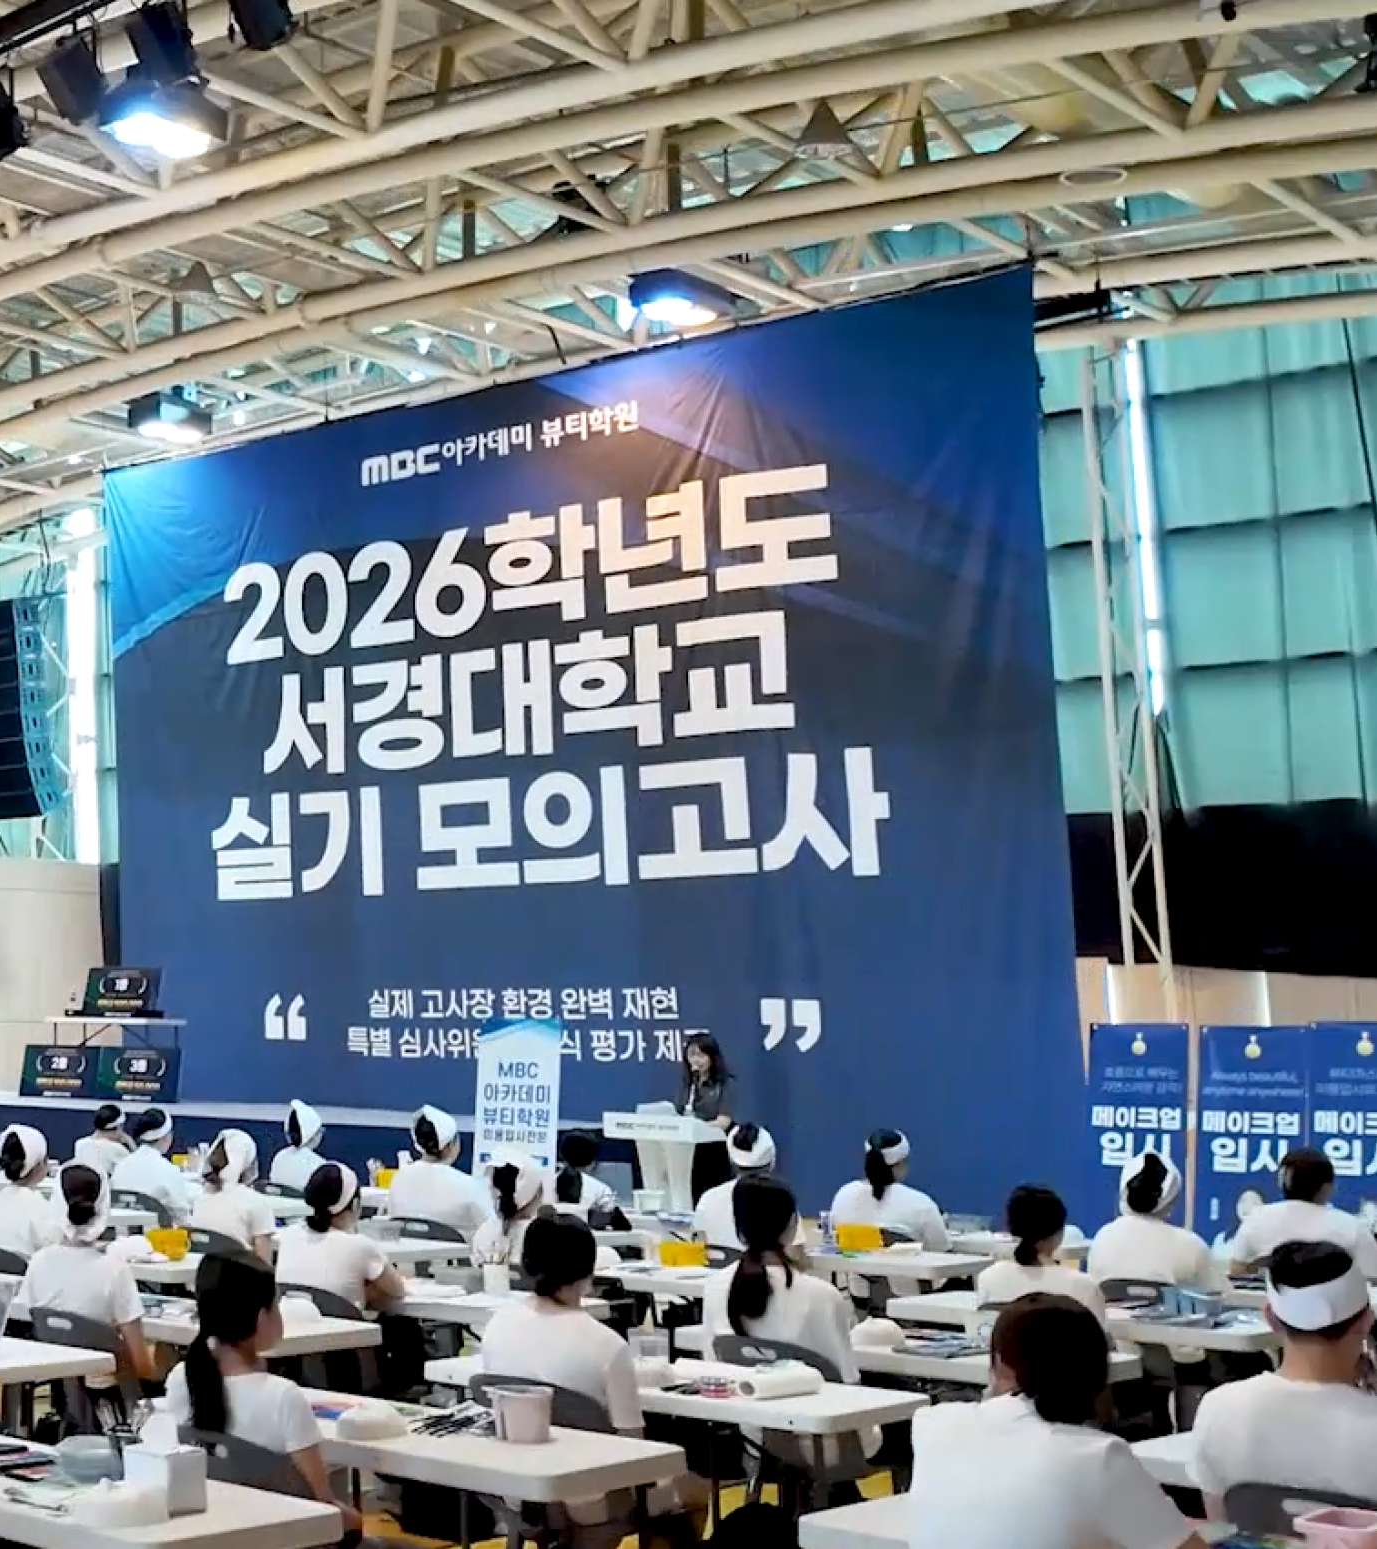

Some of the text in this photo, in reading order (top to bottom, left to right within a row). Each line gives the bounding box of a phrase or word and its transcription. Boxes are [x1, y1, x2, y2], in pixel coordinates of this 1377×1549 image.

[540, 400, 640, 448] 뷰티학원
[223, 463, 838, 665] 2026학년도
[263, 610, 796, 775] 서경대학교
[210, 746, 891, 902] 실기 모의고사
[368, 986, 679, 1020] 실제 고사장 환경 완벽 재현
[347, 1026, 391, 1057] 특별
[590, 1029, 647, 1062] 평가
[653, 1028, 711, 1062] 제
[498, 1062, 539, 1079] MBC
[483, 1082, 551, 1103] 아카데미
[483, 1106, 551, 1128] 뷰티학원
[1091, 1105, 1182, 1131] 메이크업
[1201, 1110, 1301, 1136] 메이크업
[1313, 1110, 1377, 1135] 메이크
[1323, 1137, 1377, 1177] 입
